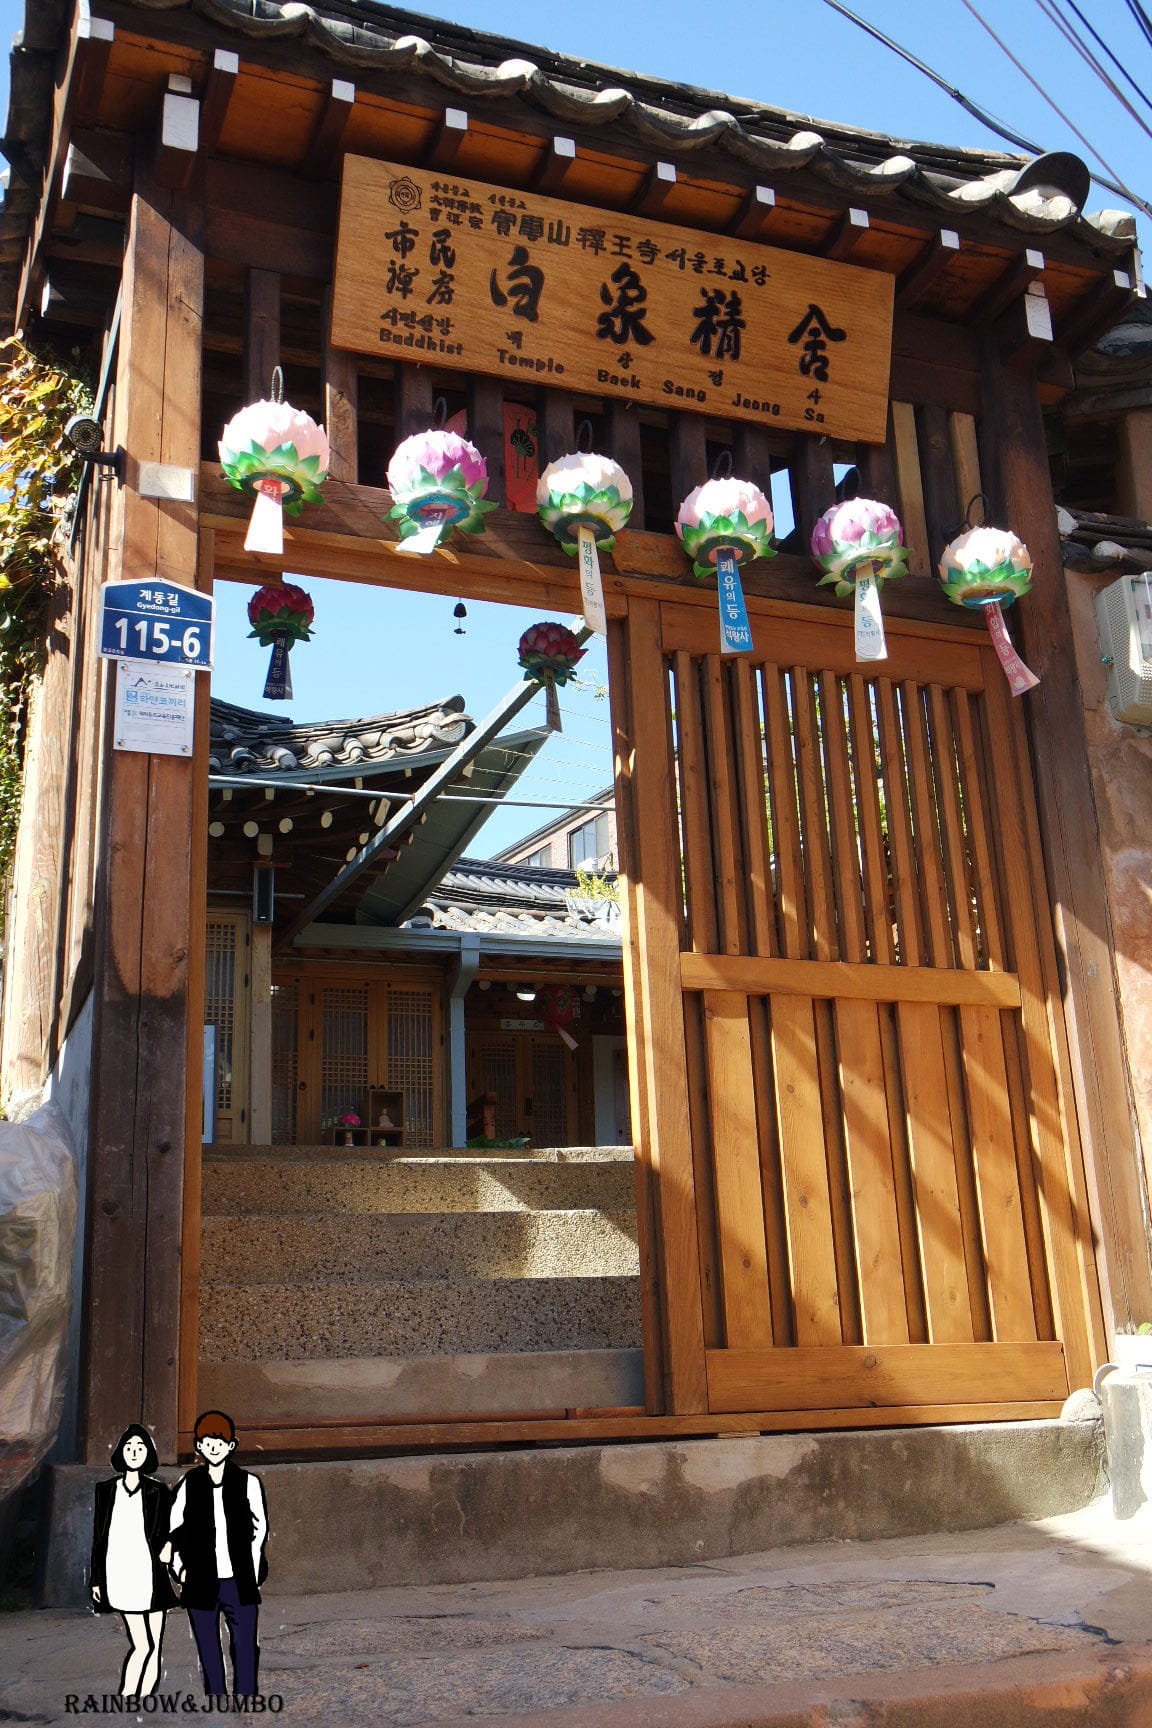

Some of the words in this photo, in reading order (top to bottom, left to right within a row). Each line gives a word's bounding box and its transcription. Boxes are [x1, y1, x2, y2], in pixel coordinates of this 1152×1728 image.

[664, 248, 771, 286] 서울포교당
[380, 328, 464, 356] Buddhist
[497, 348, 565, 374] Temple
[597, 369, 641, 390] Baek
[662, 380, 707, 403] Sang
[732, 392, 781, 416] Jeong
[804, 407, 826, 424] Sa
[137, 602, 181, 614] Gyedong-gil
[139, 589, 179, 606] 계동길
[115, 617, 201, 659] 115-6
